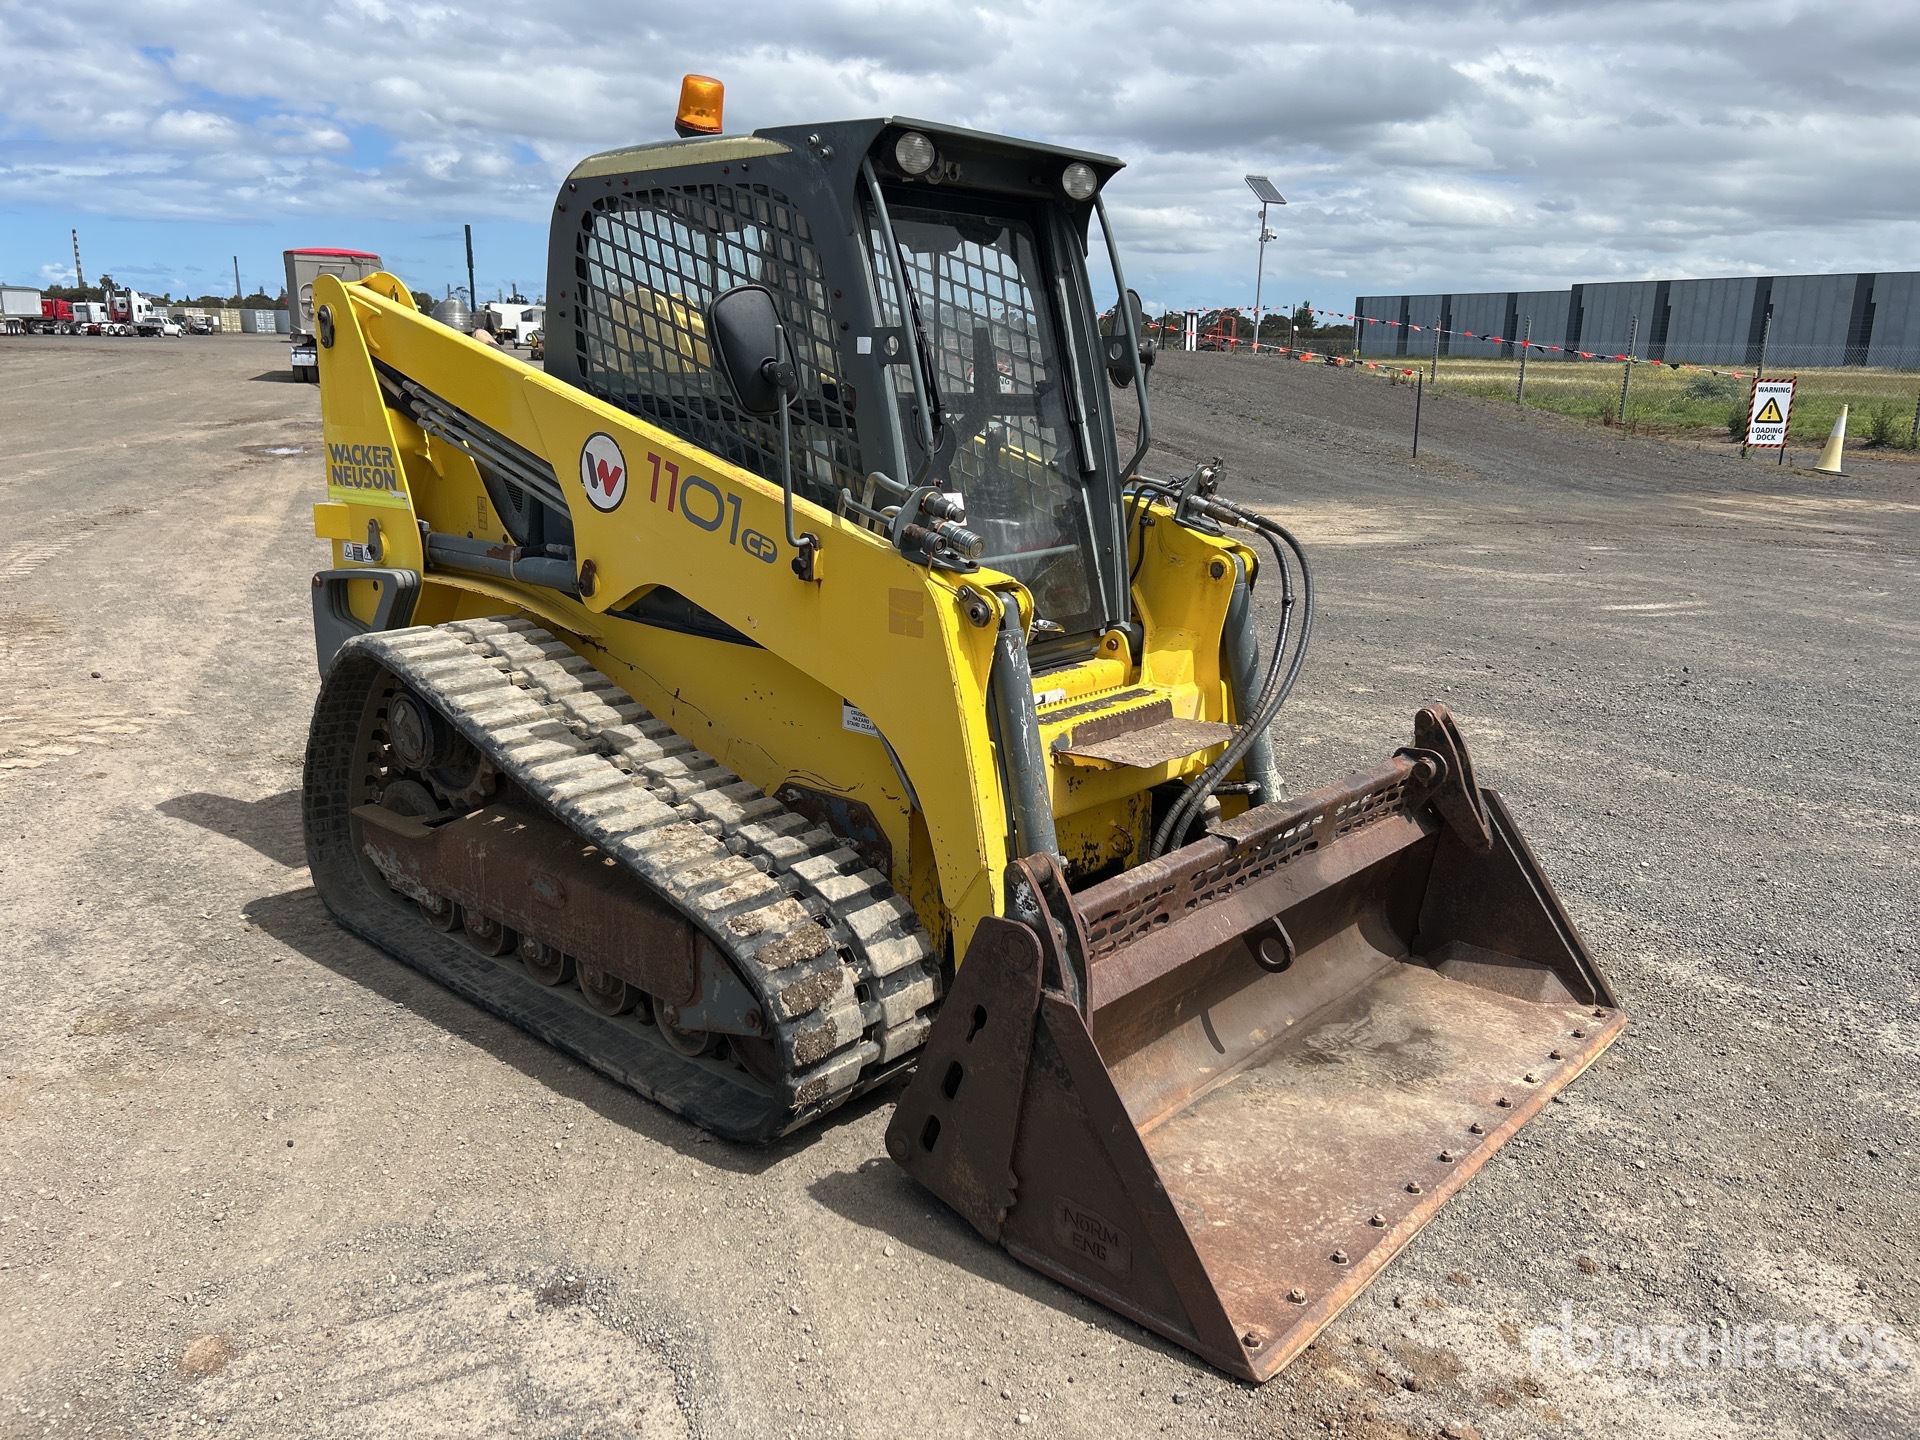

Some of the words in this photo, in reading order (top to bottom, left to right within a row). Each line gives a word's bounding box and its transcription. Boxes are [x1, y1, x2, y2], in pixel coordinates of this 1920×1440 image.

[328, 443, 395, 469] WACKER
[332, 465, 397, 491] NEUSON
[1064, 1207, 1119, 1247] NORM
[1072, 1231, 1107, 1262] ENG
